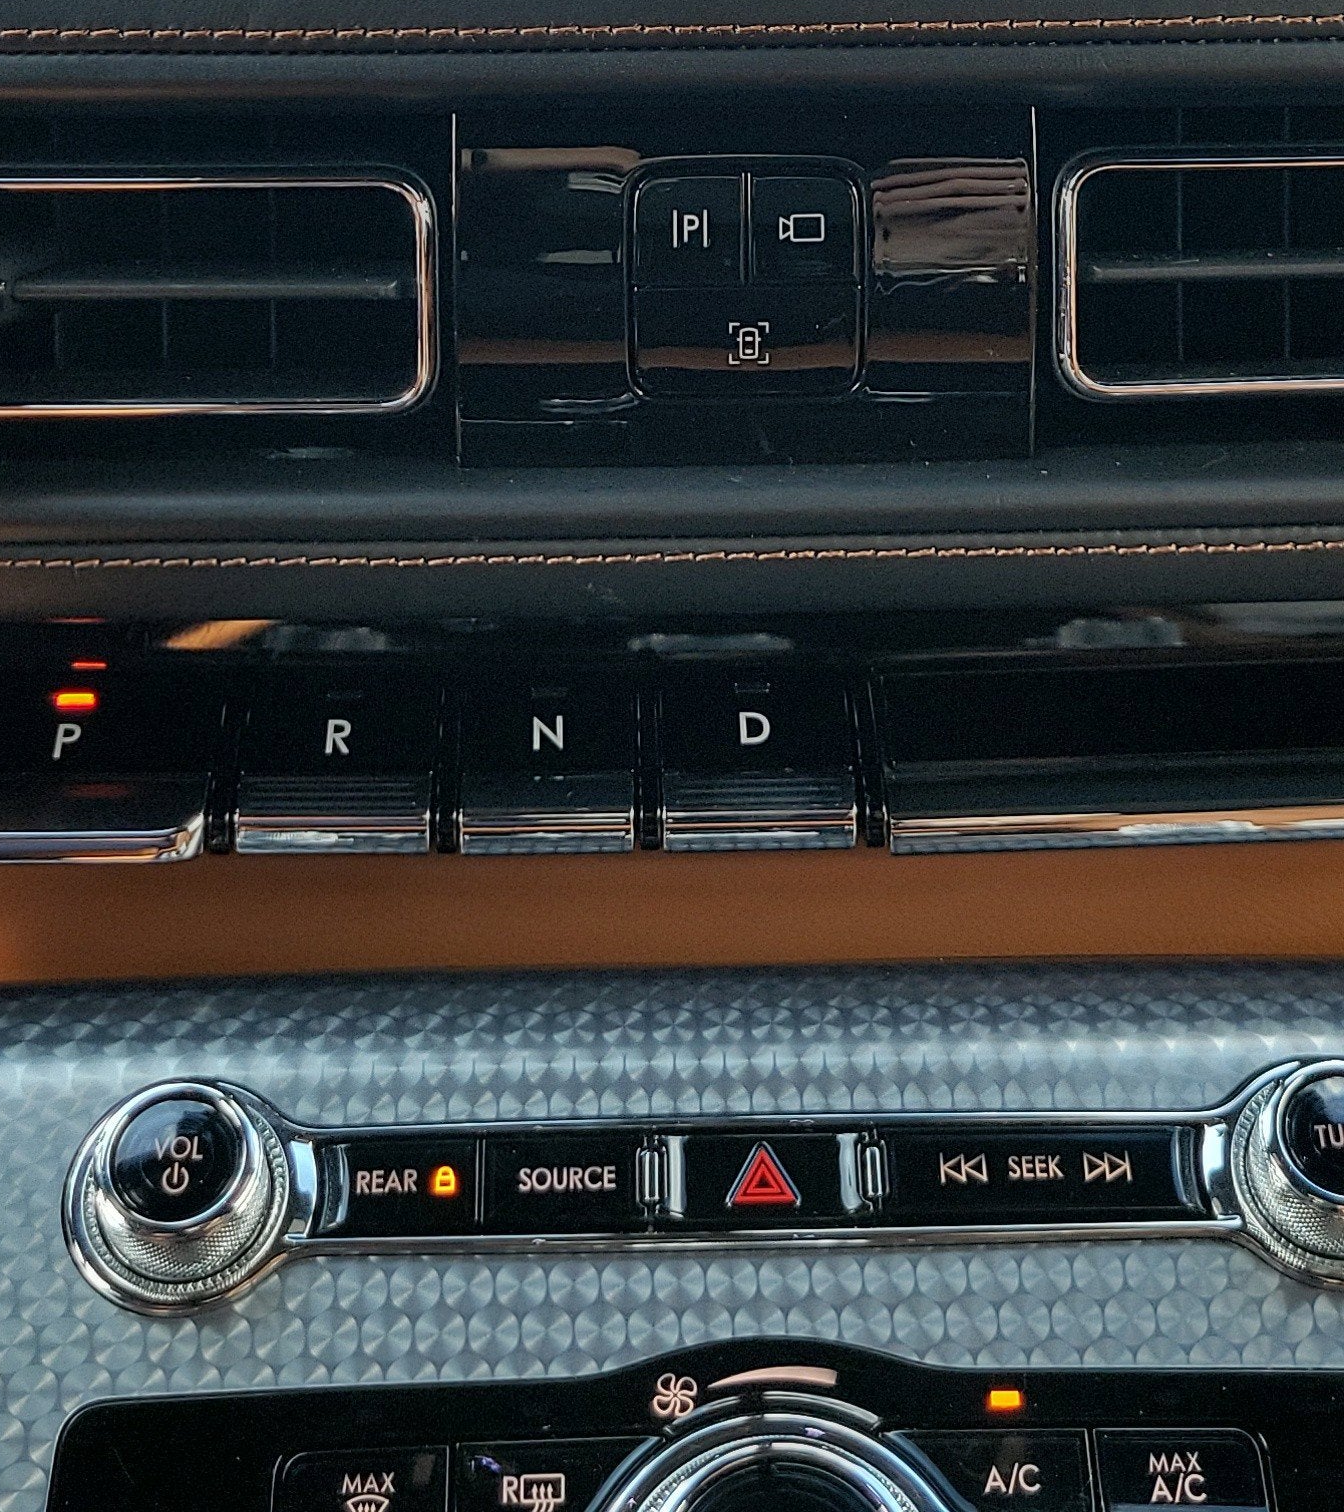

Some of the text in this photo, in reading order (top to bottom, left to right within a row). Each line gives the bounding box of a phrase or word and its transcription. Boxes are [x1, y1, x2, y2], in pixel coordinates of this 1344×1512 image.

[52, 723, 82, 760] P
[324, 719, 352, 756] R
[532, 715, 564, 751] N
[739, 711, 772, 745] D
[156, 1135, 203, 1161] VOL
[519, 1166, 616, 1192] SOURCE
[1008, 1155, 1064, 1179] SEEK
[357, 1170, 418, 1192] REAR
[1149, 1451, 1201, 1473] MAX
[342, 1471, 395, 1492] MAX
[984, 1465, 1042, 1495] A/C
[1151, 1474, 1207, 1503] A/C
